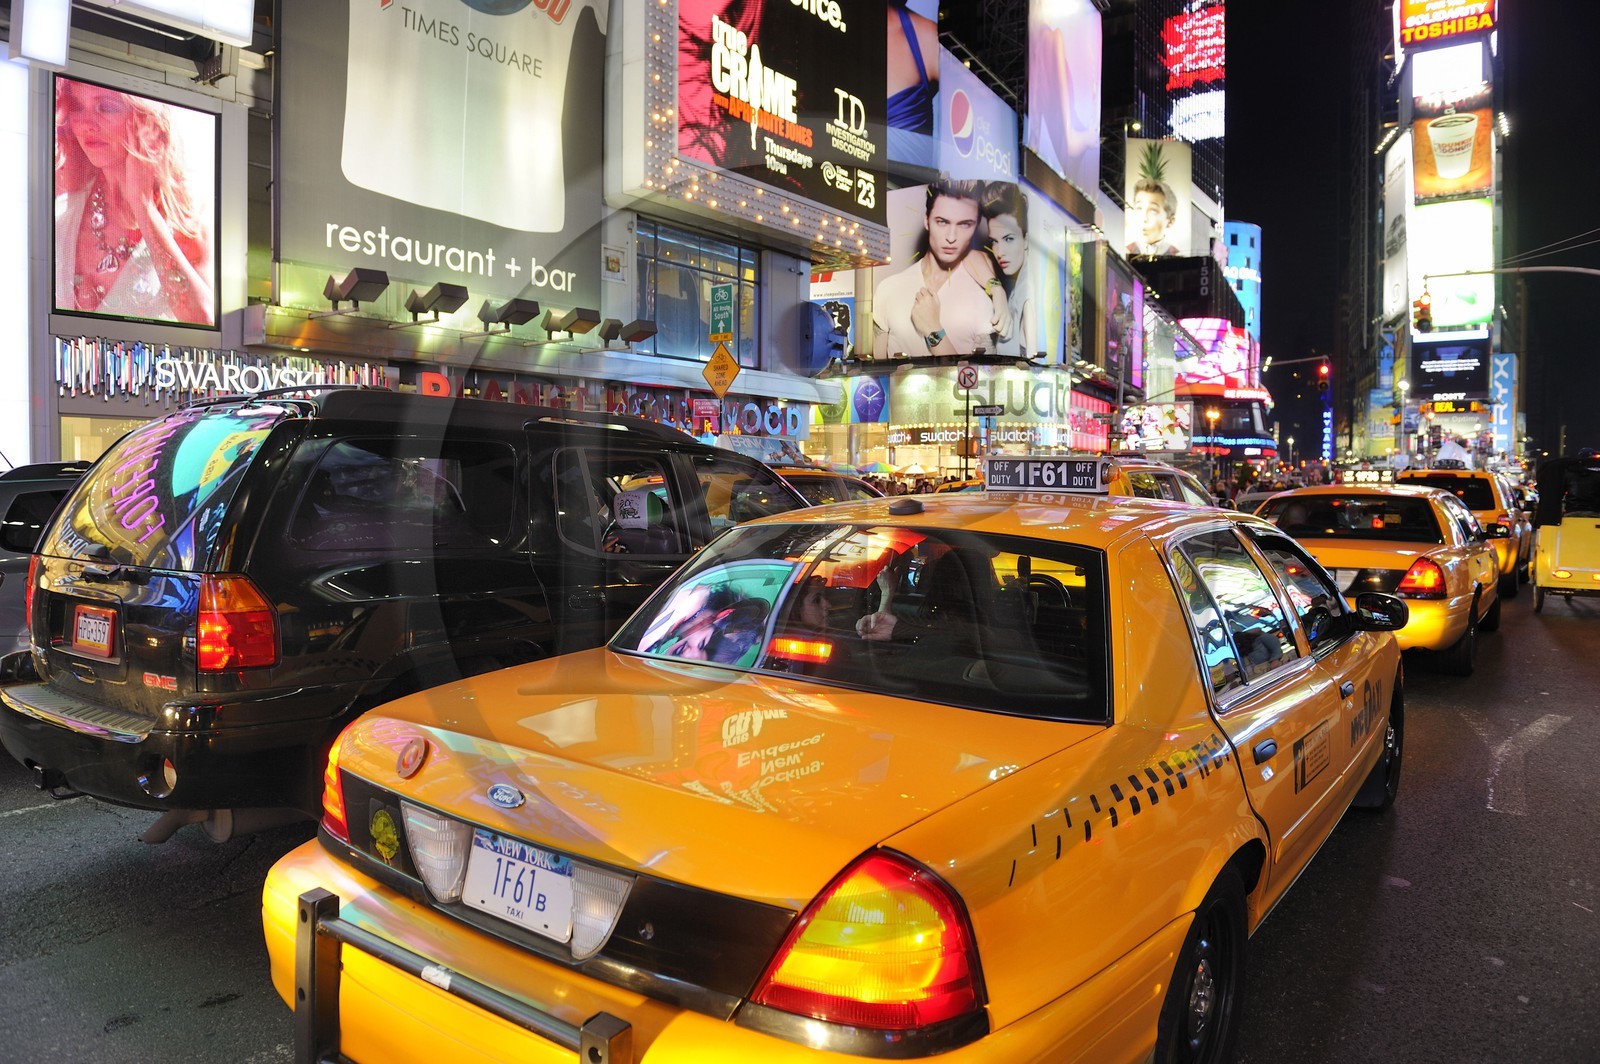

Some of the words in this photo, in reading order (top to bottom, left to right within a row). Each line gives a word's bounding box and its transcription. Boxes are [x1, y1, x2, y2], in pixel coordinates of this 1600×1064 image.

[711, 14, 748, 56] true
[1402, 13, 1493, 43] TOSHIBA
[401, 6, 459, 46] TIMES
[466, 32, 543, 79] SQUARE
[834, 87, 866, 137] ID
[784, 119, 813, 148] JONES
[825, 122, 876, 154] INVESTIGATION
[764, 136, 814, 169] Thursdays
[831, 136, 870, 162] DISCOVERY
[976, 134, 1012, 177] pepsi
[765, 154, 788, 175] 10PM
[857, 179, 876, 209] 23
[325, 222, 496, 277] restaurant
[531, 257, 577, 293] bar
[1200, 257, 1209, 296] 1500
[714, 312, 729, 321] South
[155, 358, 324, 397] SWAROVSKI
[713, 364, 729, 373] SHARED
[715, 372, 726, 380] ZONE
[714, 380, 728, 388] AHEAD
[920, 430, 965, 443] swatch
[990, 430, 1035, 443] swatch
[991, 474, 1011, 484] DUTY
[1072, 476, 1095, 487] DUTY
[994, 461, 1010, 472] OFF
[1014, 462, 1067, 486] 1F61
[1075, 462, 1094, 473] OFF
[142, 672, 178, 691] GMC
[493, 789, 514, 803] Ford
[497, 837, 521, 858] NEW
[523, 844, 551, 869] YORK
[506, 906, 524, 919] TAXI
